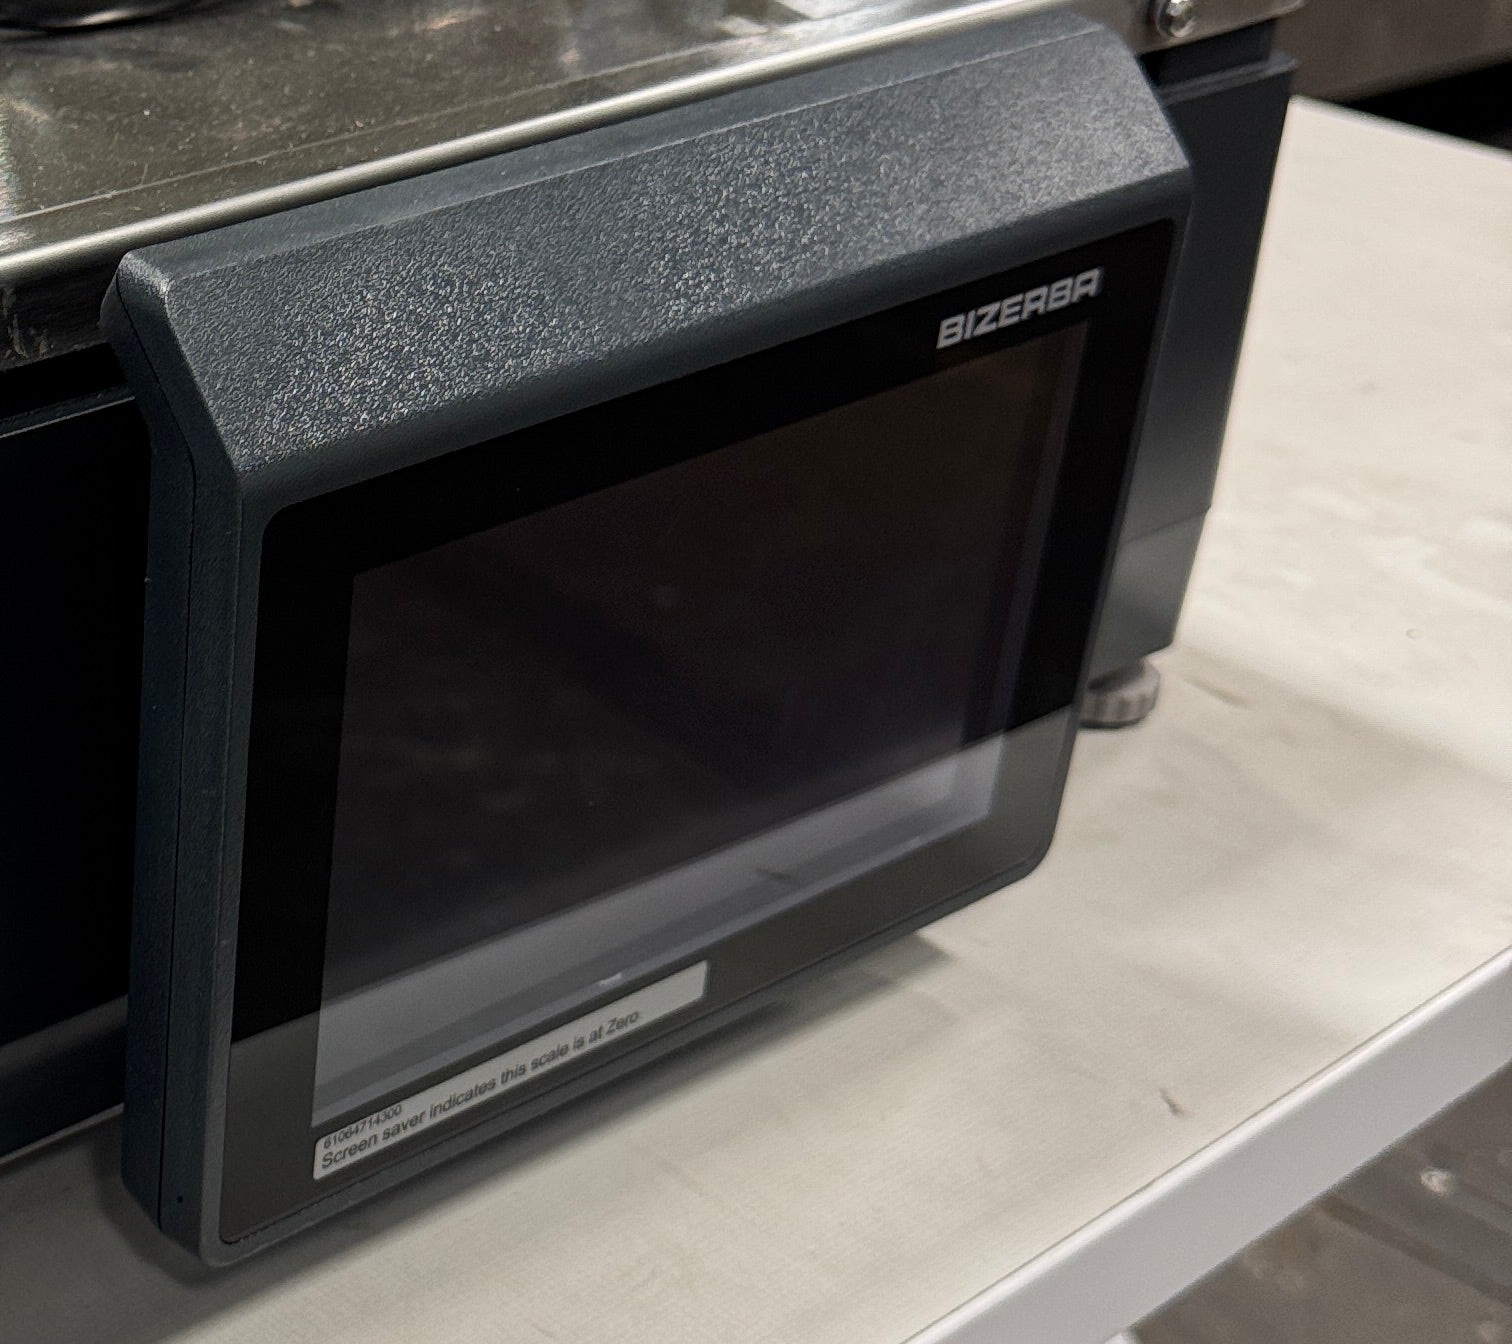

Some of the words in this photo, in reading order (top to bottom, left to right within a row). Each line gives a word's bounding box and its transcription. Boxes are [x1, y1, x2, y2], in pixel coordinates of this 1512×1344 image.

[937, 267, 1102, 349] BIZERBA
[321, 1133, 379, 1170] Screen
[381, 1109, 427, 1142] saver
[429, 1077, 497, 1120] indicates
[500, 1062, 527, 1085] this
[530, 1042, 570, 1072] scale
[572, 1035, 586, 1053] is
[588, 1024, 604, 1045] at
[605, 1010, 640, 1036] Zero
